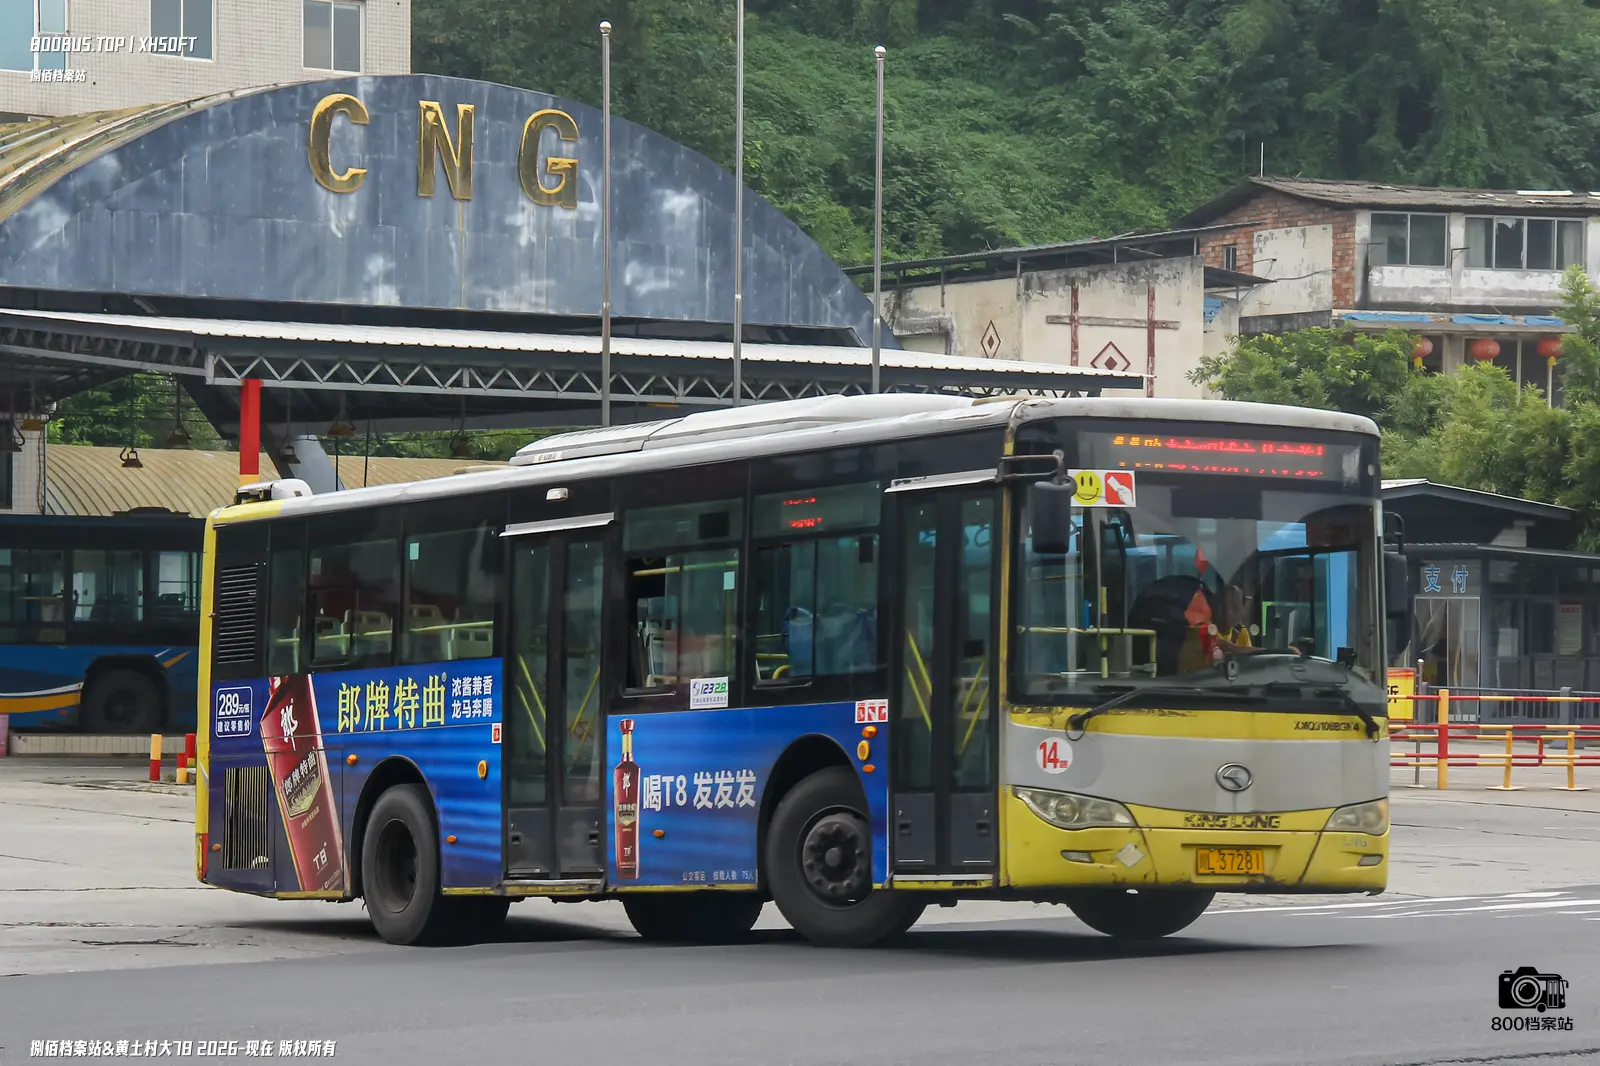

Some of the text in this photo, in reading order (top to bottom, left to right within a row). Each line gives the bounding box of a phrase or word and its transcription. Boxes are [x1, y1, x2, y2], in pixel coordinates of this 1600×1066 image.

[308, 93, 580, 209] CNG
[1424, 565, 1469, 594] 支付
[451, 675, 493, 697] 浓酱兼香
[700, 682, 727, 694] 12328
[337, 674, 446, 733] 郎牌特曲
[451, 697, 493, 719] 龙马奔腾
[643, 768, 757, 812] 喝T8 发发发
[1183, 813, 1281, 830] KING LONG
